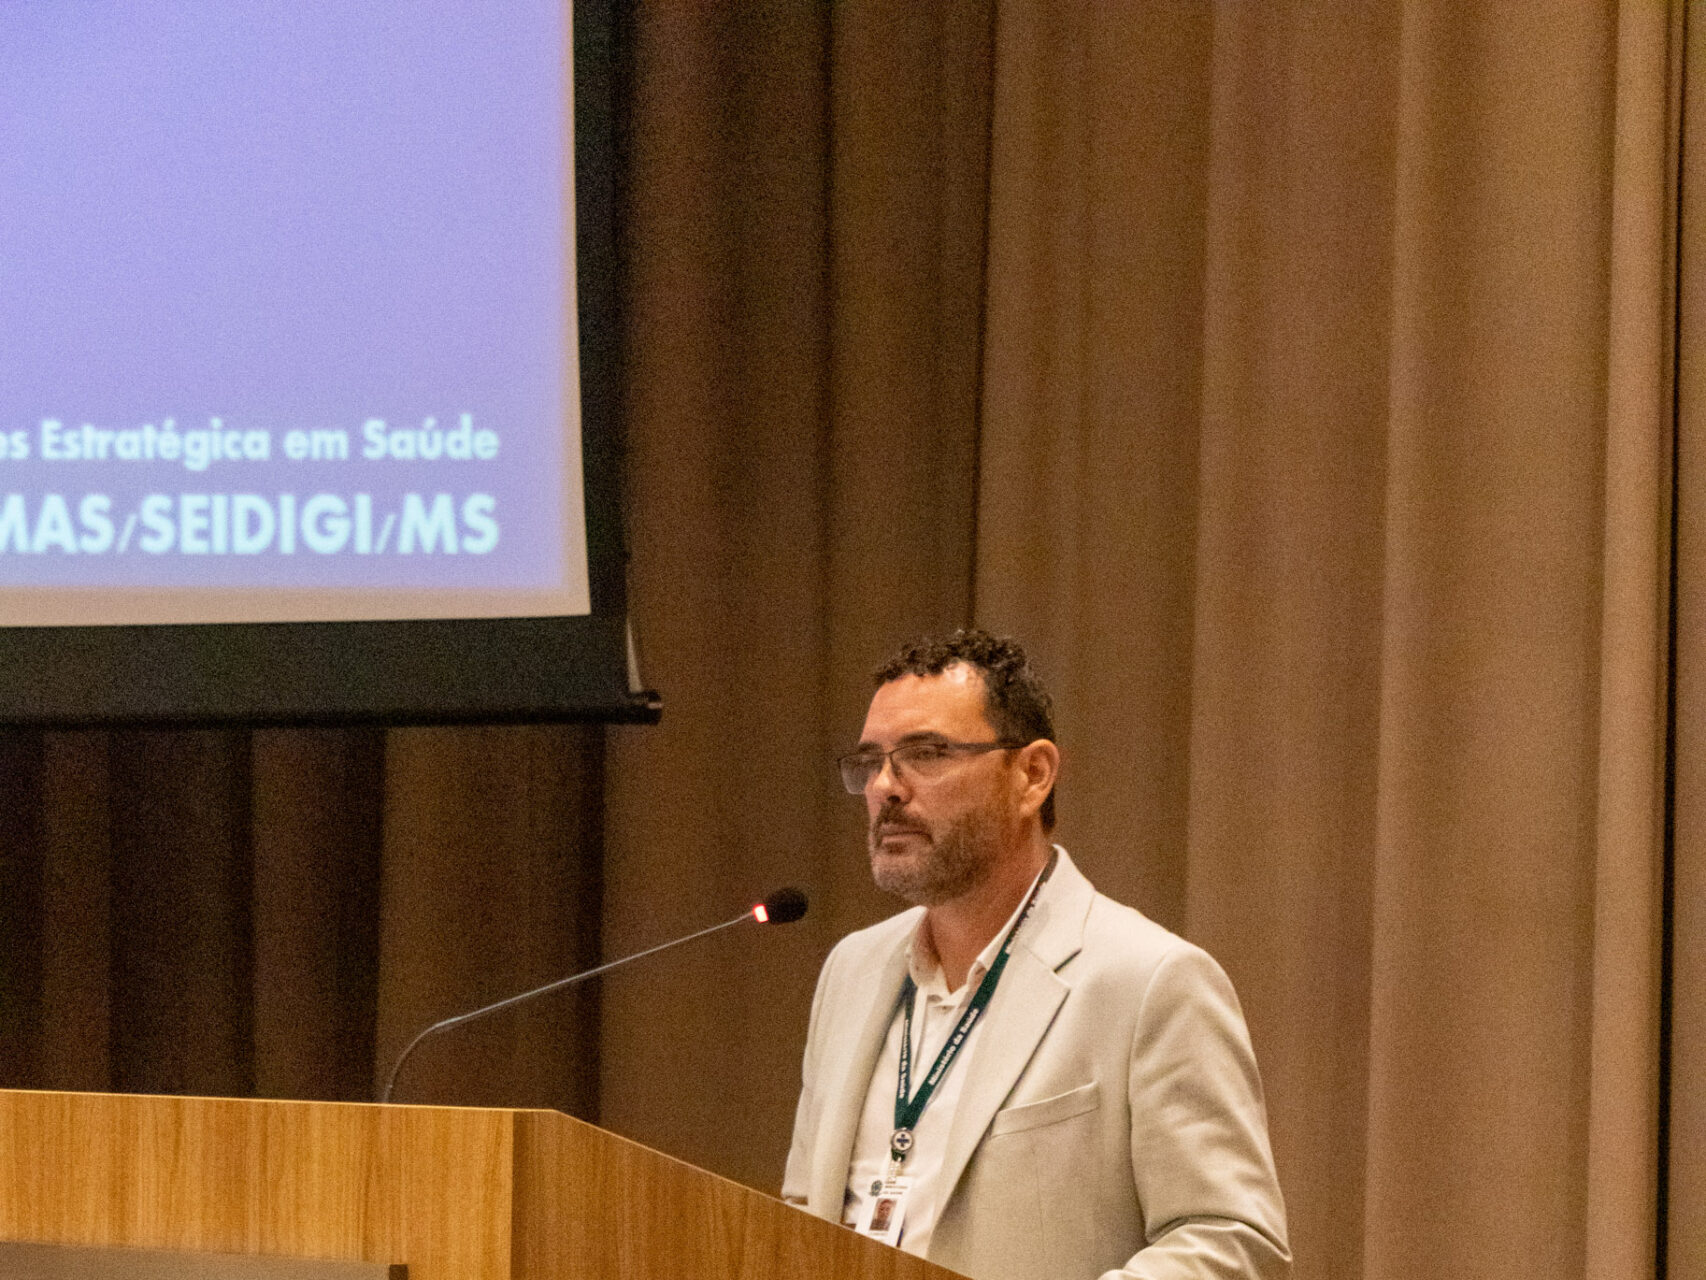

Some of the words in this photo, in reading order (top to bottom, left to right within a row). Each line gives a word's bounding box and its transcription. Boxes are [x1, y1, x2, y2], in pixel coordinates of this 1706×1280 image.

[41, 416, 270, 471] Estratégica
[284, 429, 349, 460] em
[362, 412, 501, 461] Saúde
